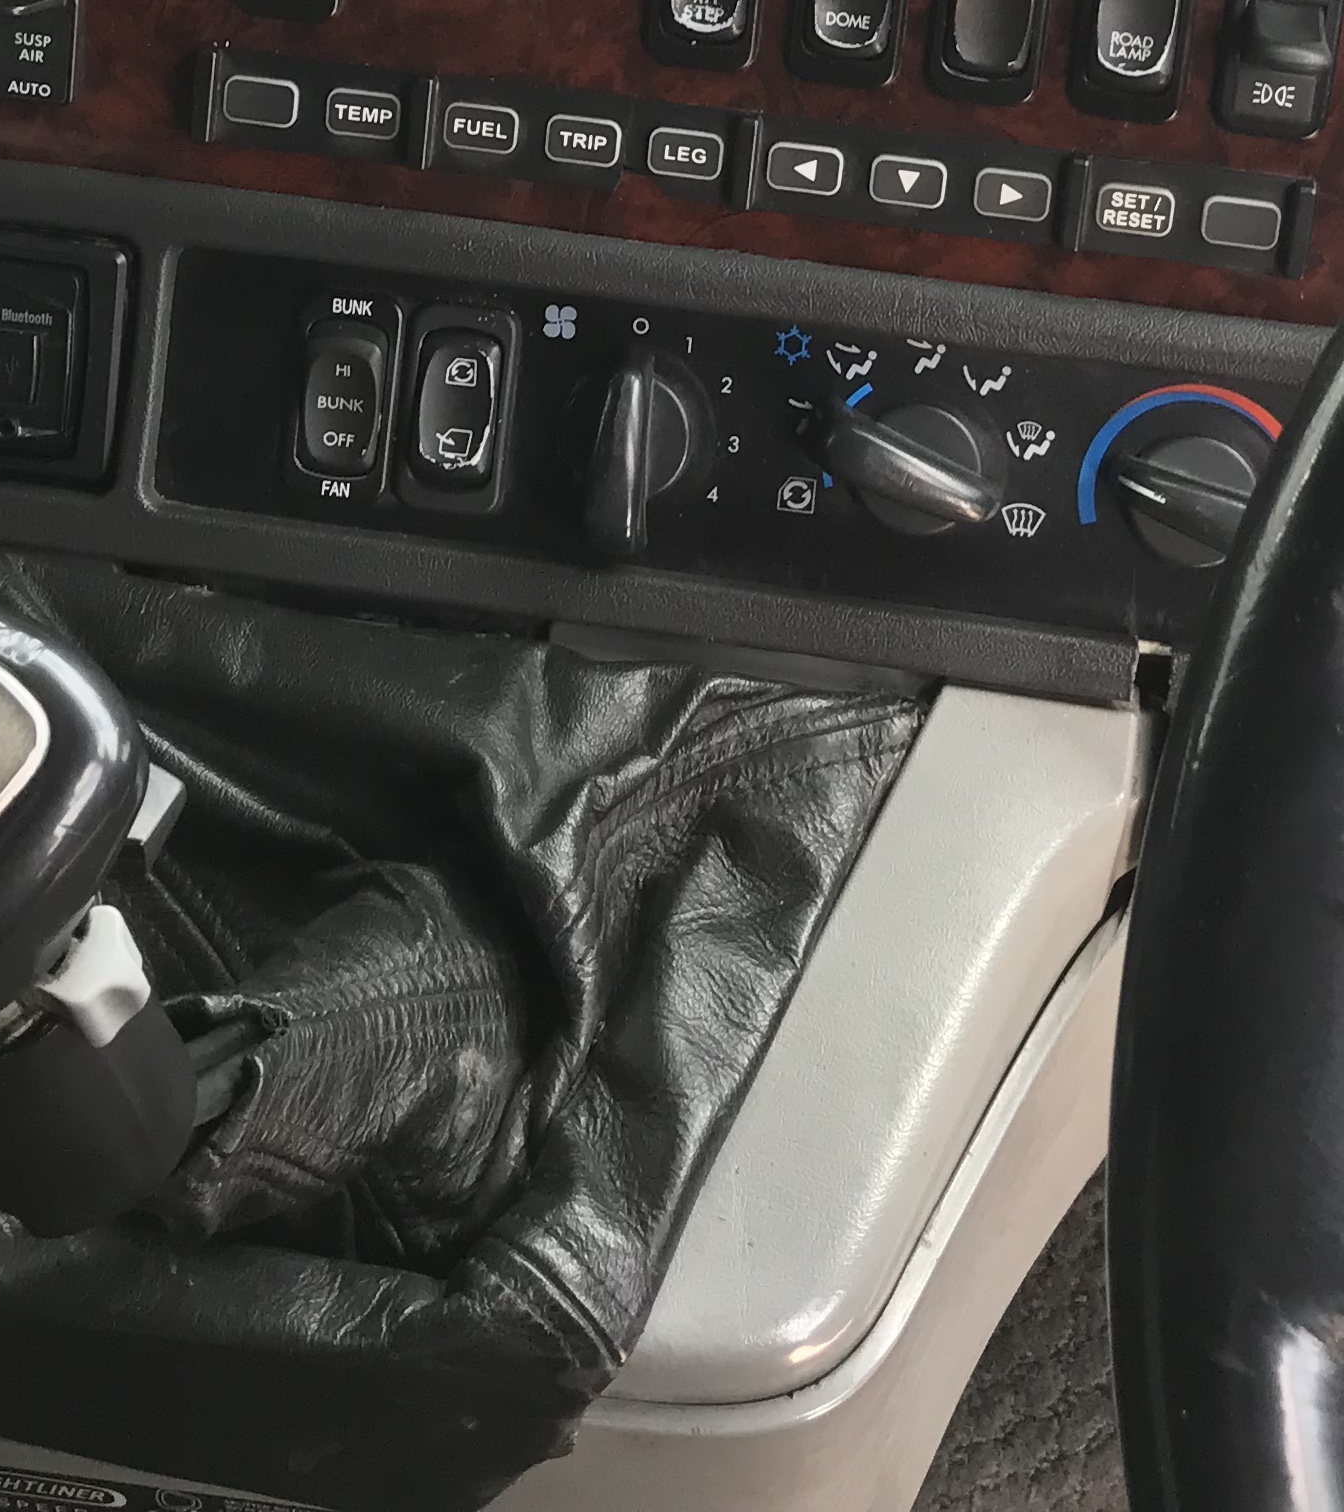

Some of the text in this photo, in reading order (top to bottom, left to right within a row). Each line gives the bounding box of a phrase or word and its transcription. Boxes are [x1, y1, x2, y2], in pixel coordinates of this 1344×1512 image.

[683, 4, 725, 23] STEP
[825, 11, 871, 30] DOME
[14, 32, 52, 48] SUSP
[1110, 30, 1155, 49] ROAD
[18, 48, 44, 63] AIR
[1109, 45, 1152, 62] LAMP
[7, 80, 51, 98] AUTO
[334, 103, 393, 125] TEMP
[452, 117, 507, 141] FUEL
[559, 130, 608, 152] TRIP
[663, 143, 708, 165] LEG
[1103, 209, 1166, 231] RESET
[332, 297, 374, 317] BUNK
[1, 307, 54, 326] Bluetooth
[686, 336, 693, 354] 1
[335, 363, 351, 377] HI
[720, 376, 732, 394] 2
[317, 395, 364, 413] BUNK
[323, 431, 355, 448] OFF
[727, 435, 740, 453] 3
[321, 480, 351, 498] FAN
[706, 486, 718, 503] 4
